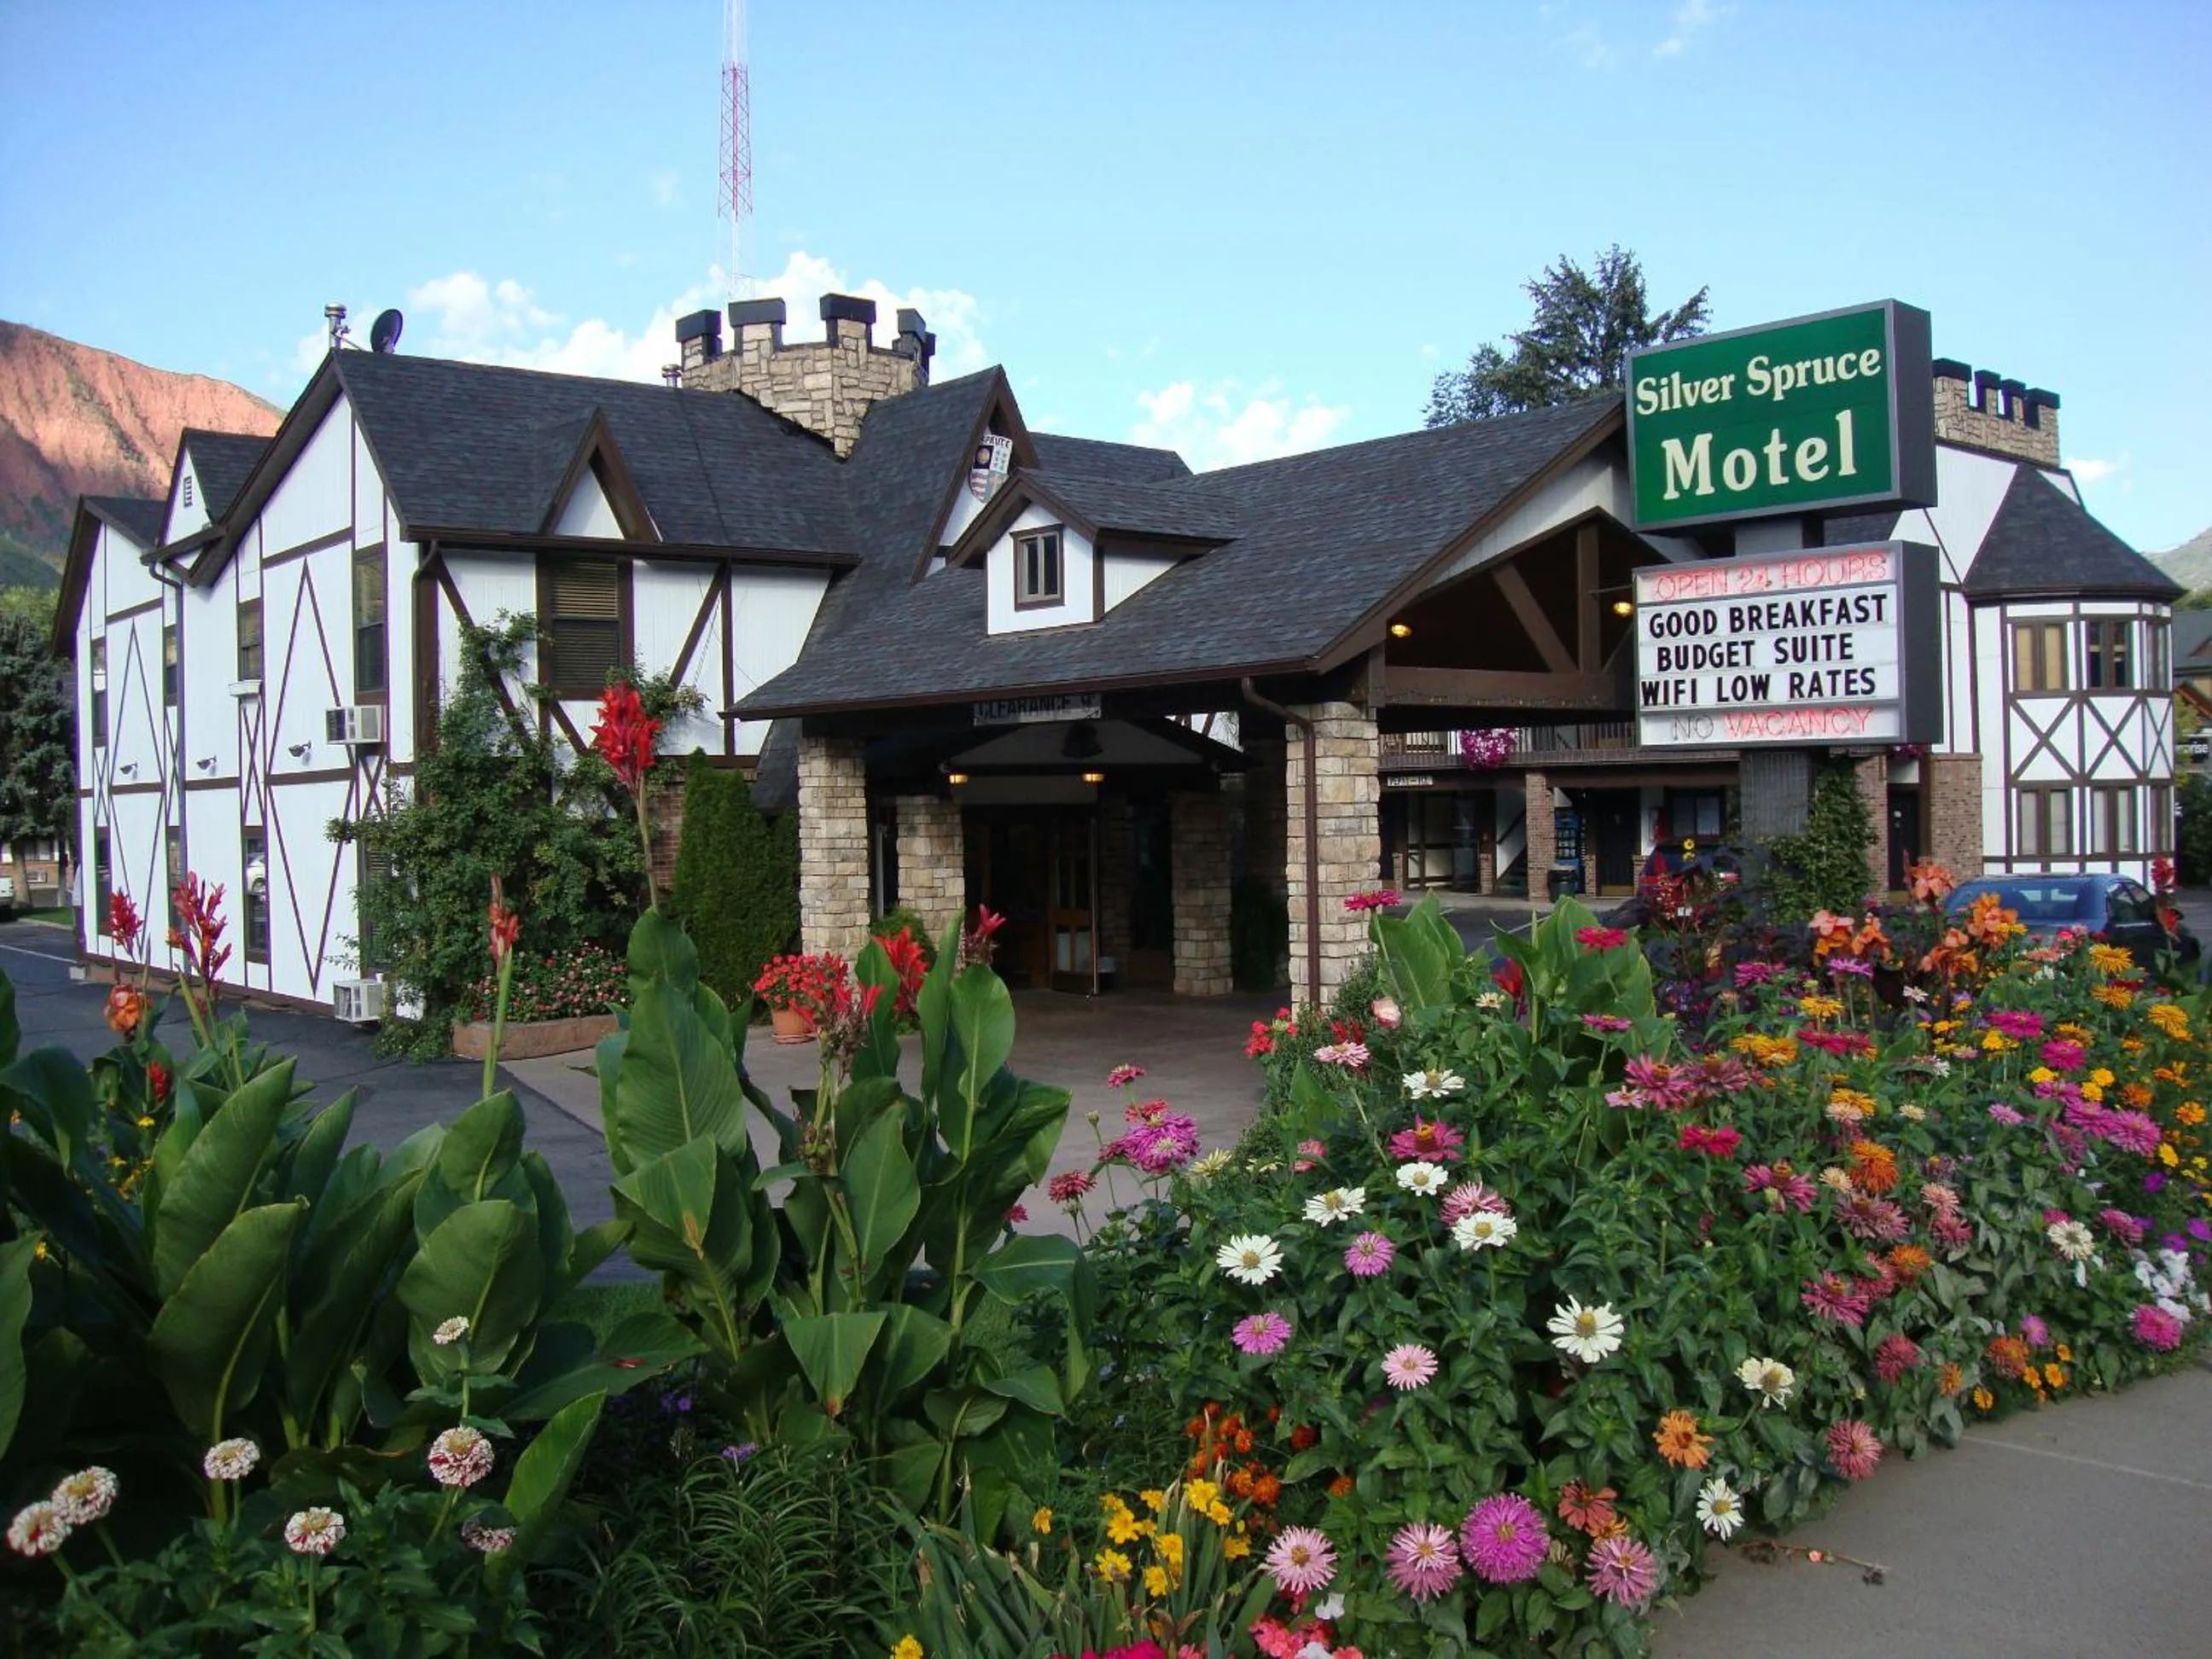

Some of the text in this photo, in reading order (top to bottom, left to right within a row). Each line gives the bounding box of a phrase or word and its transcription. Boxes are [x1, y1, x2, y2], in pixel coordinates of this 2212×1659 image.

[1636, 348, 1882, 415] Silver Spruce
[1661, 409, 1858, 500] Motel
[1656, 555, 1887, 600] OPEN 24 HOURS
[1649, 594, 1888, 638] GOOD BREAKFAST
[1656, 633, 1854, 672] BUDGET SUITE
[978, 696, 1070, 719] CLEARANCE
[1641, 667, 1877, 707] WIFI LOW RATES
[1673, 707, 1874, 741] NO VACANCY
